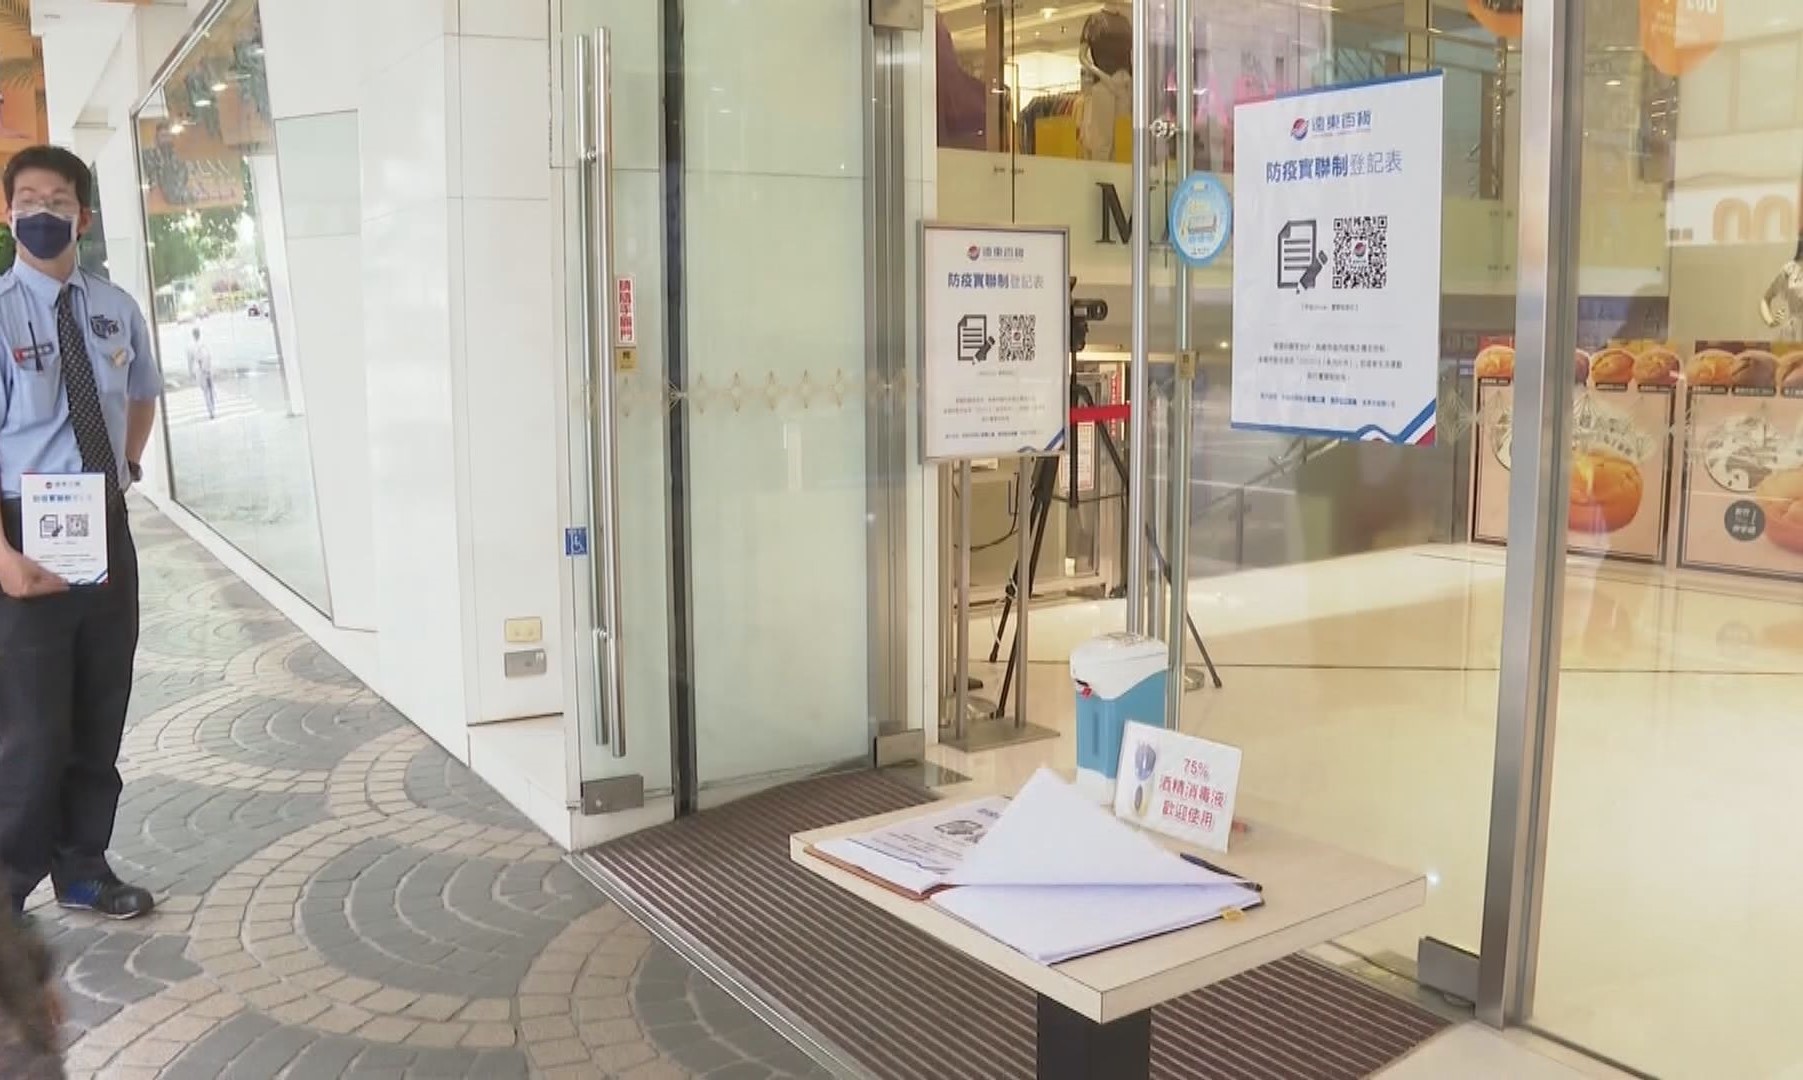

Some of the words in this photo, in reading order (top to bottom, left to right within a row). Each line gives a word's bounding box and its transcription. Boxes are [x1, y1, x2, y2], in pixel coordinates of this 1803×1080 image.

[1311, 111, 1371, 131] 遠東百貨
[1266, 150, 1402, 183] 防疫實聯制登記表
[948, 272, 1044, 289] 防疫實聯制登記表
[1184, 759, 1209, 778] 75%
[1160, 777, 1225, 807] 酒精消毒液
[1162, 801, 1213, 828] 歡迎使用
